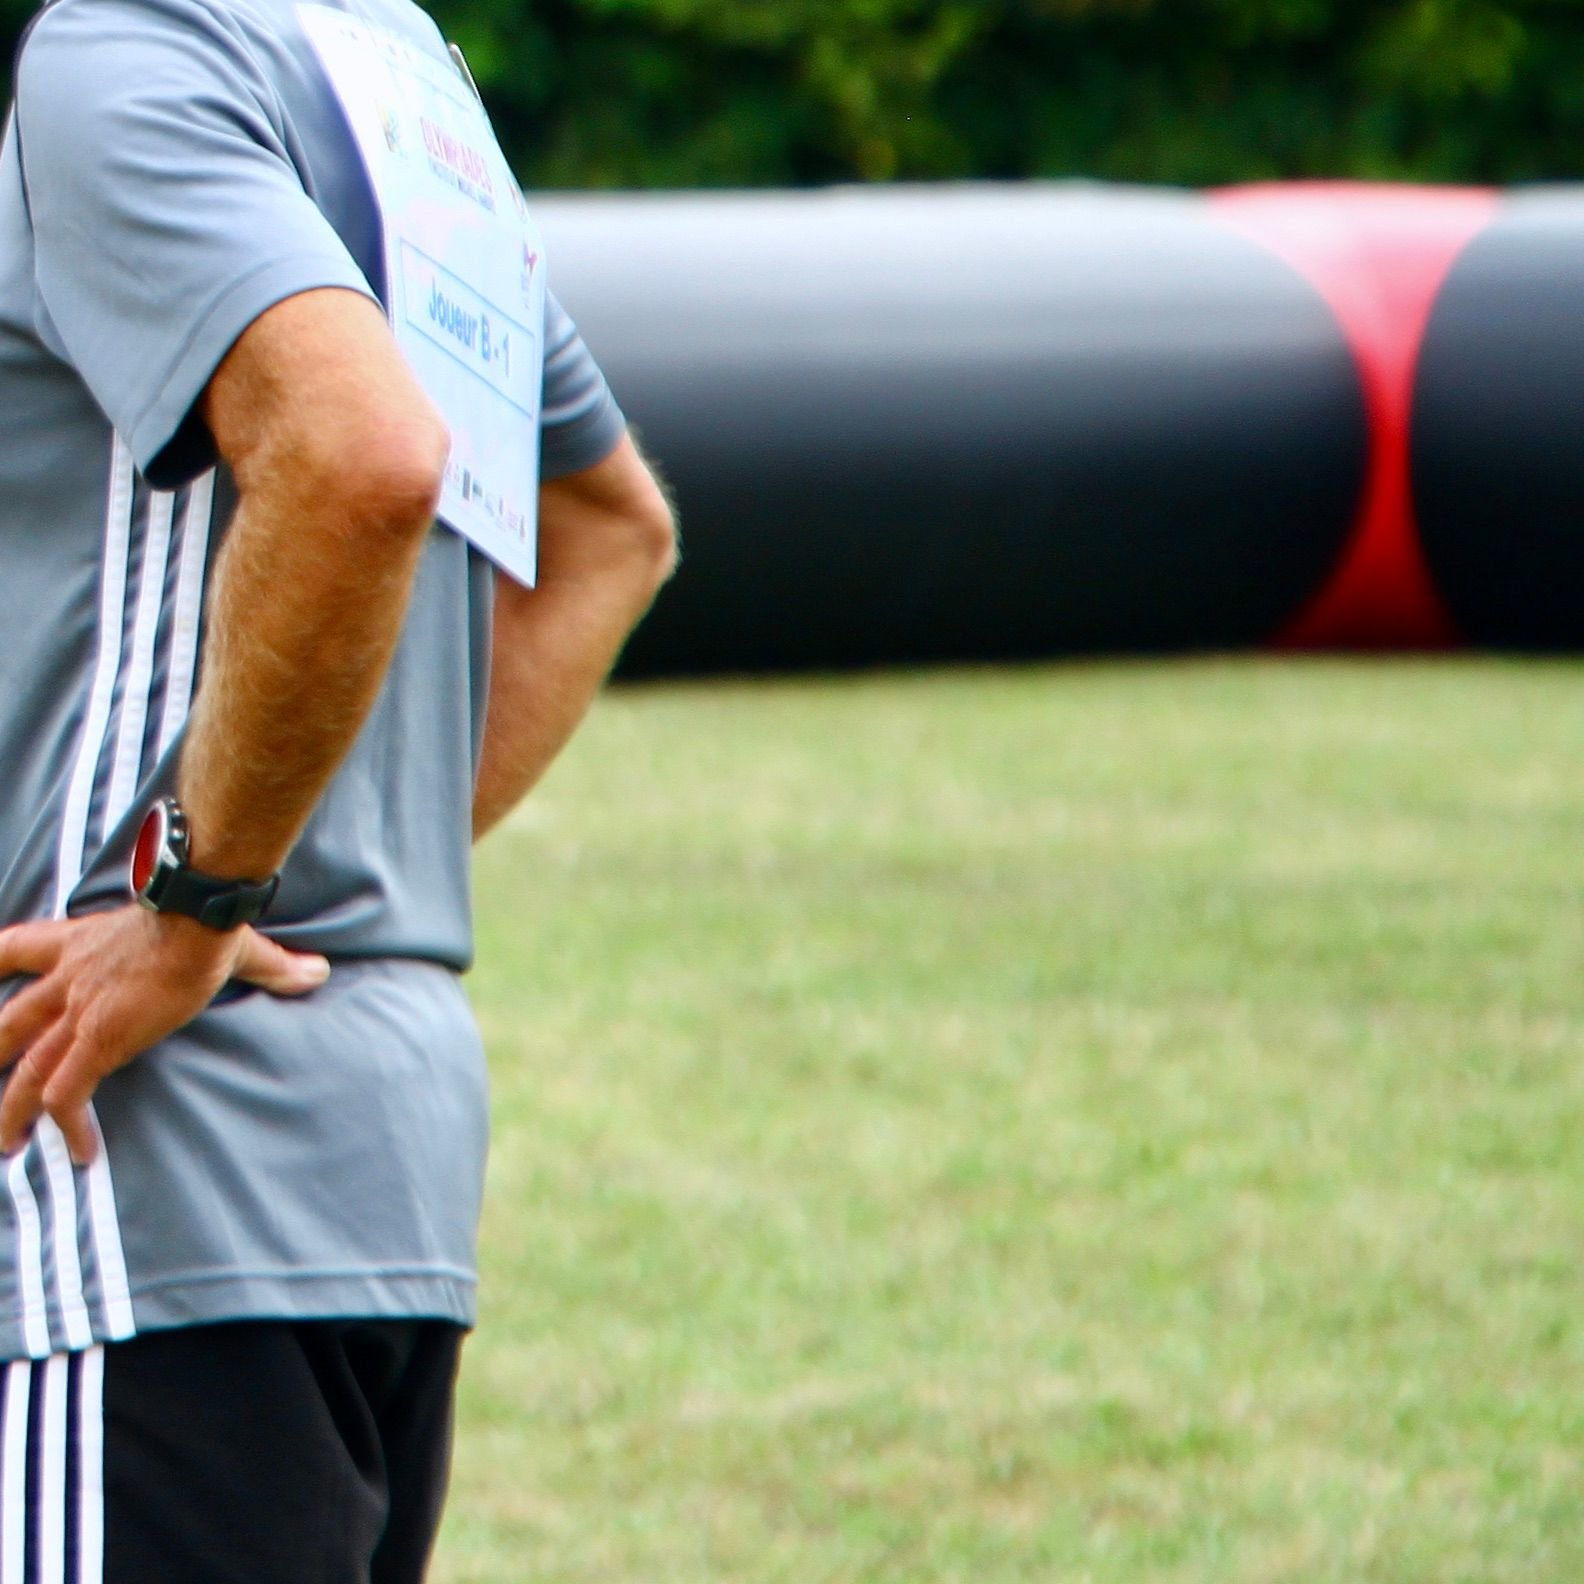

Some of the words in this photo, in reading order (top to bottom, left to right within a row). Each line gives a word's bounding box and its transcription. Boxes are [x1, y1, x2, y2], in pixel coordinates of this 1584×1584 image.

[429, 275, 478, 352] Joueur
[481, 312, 492, 363] B
[503, 332, 510, 379] 1
